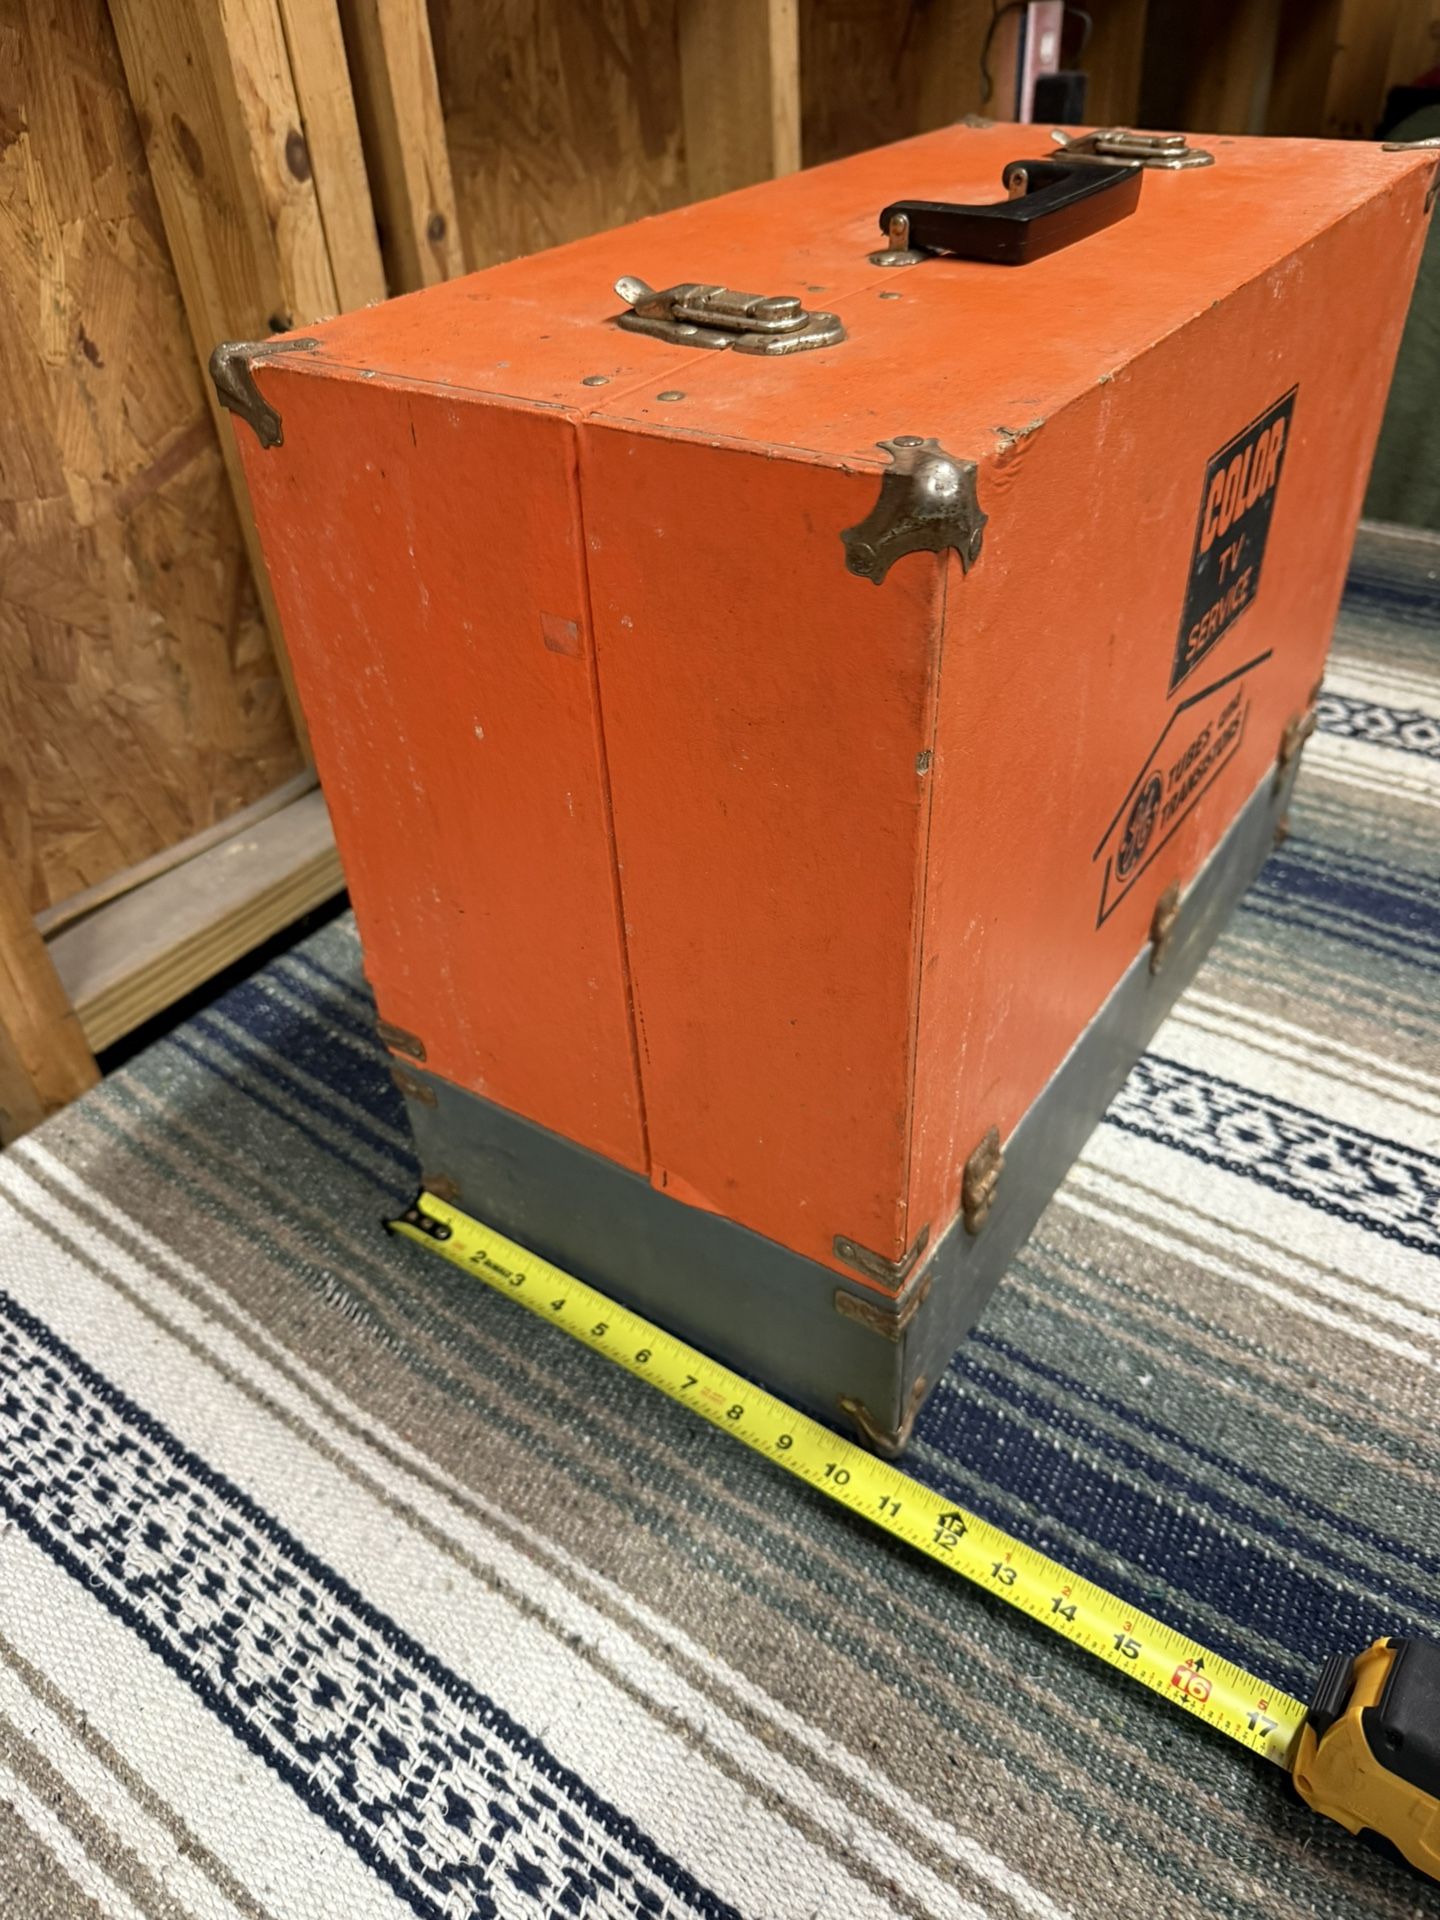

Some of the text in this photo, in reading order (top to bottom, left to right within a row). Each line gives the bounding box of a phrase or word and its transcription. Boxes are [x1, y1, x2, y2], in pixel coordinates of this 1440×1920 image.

[1200, 415, 1286, 555] COLOR
[1184, 566, 1253, 662] SERVICE
[1218, 532, 1246, 585] TV
[469, 1250, 1279, 1739] 2 3 4 5 6 7 8 9 10 11 12 13 14 15 16 17
[1061, 1585, 1072, 1598] 2
[1123, 1620, 1133, 1633] 3
[1185, 1657, 1195, 1669] 4
[1257, 1699, 1269, 1711] 5
